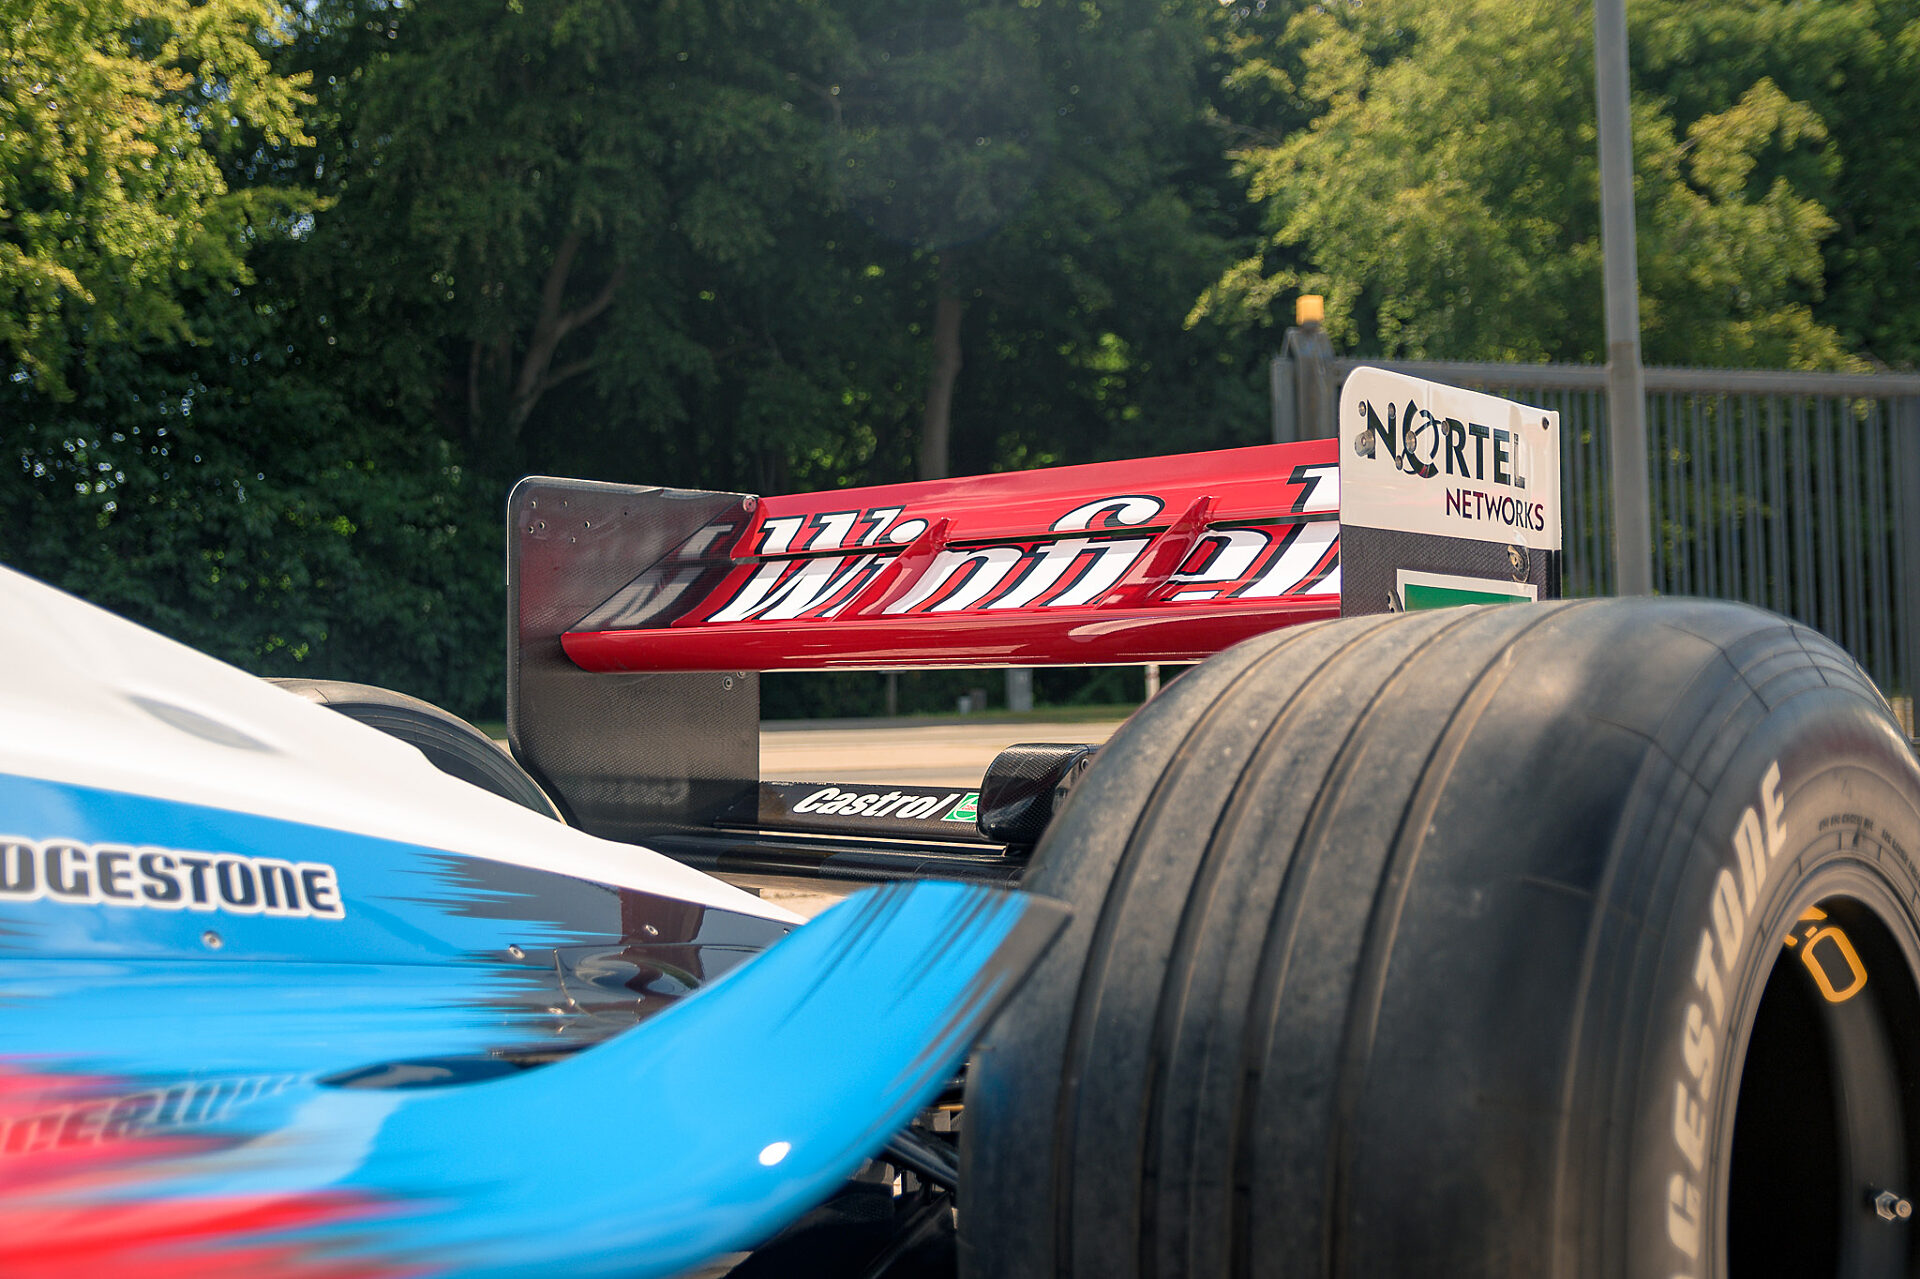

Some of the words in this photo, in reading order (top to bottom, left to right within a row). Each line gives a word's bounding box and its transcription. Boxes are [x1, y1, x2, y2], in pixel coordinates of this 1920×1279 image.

[1366, 399, 1526, 490] NORTEL
[702, 462, 1340, 622] Winfiel
[1445, 487, 1545, 531] NETWORKS
[793, 787, 961, 820] Castrol
[1667, 760, 1788, 1279] GESTONE
